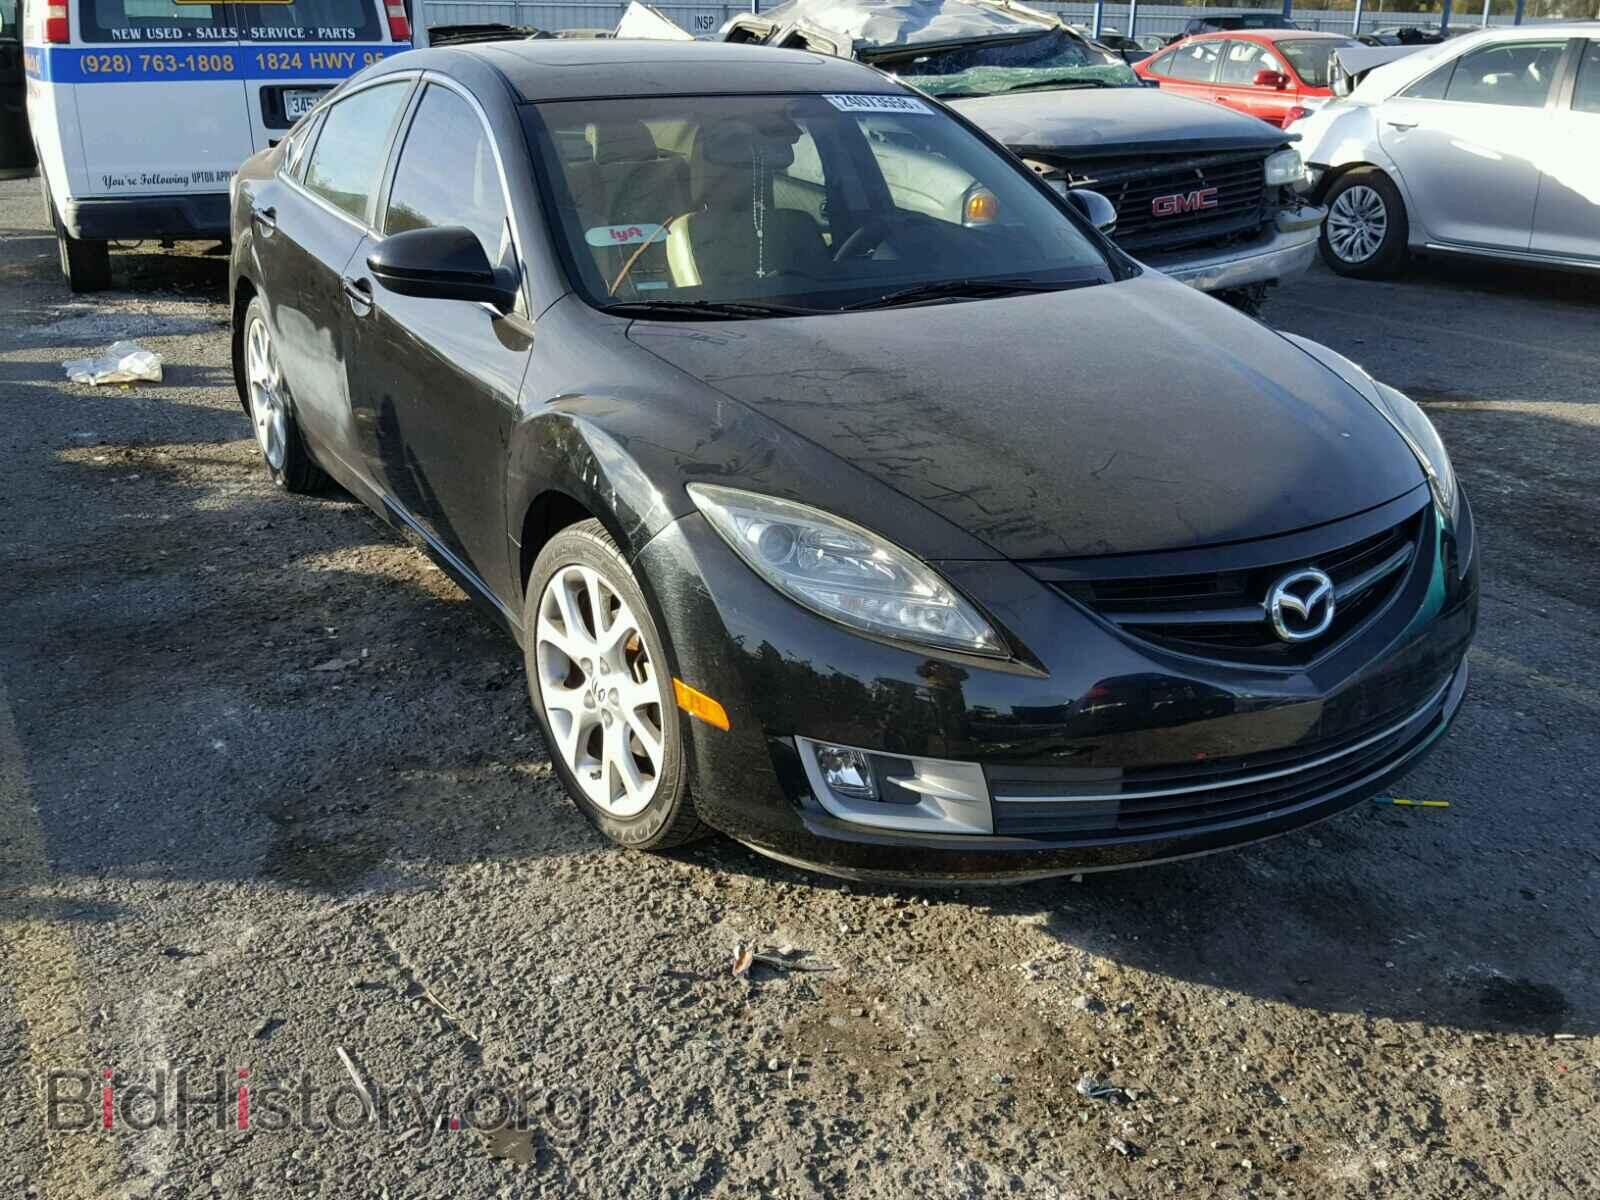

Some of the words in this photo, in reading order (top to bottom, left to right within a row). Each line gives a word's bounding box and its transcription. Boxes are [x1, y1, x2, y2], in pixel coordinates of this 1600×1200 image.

[694, 15, 714, 30] INSP
[111, 28, 141, 40] NEW
[146, 27, 183, 39] USED
[196, 27, 238, 39] SALES
[251, 27, 306, 39] SERVICE
[318, 27, 356, 39] PARTS
[80, 54, 132, 76] (928)
[139, 54, 235, 73] 763-1808
[256, 52, 303, 70] 1824
[309, 52, 356, 70] HWY
[102, 174, 138, 190] You're
[140, 172, 189, 188] Following
[191, 170, 215, 184] UPTON
[1151, 187, 1218, 217] GMC
